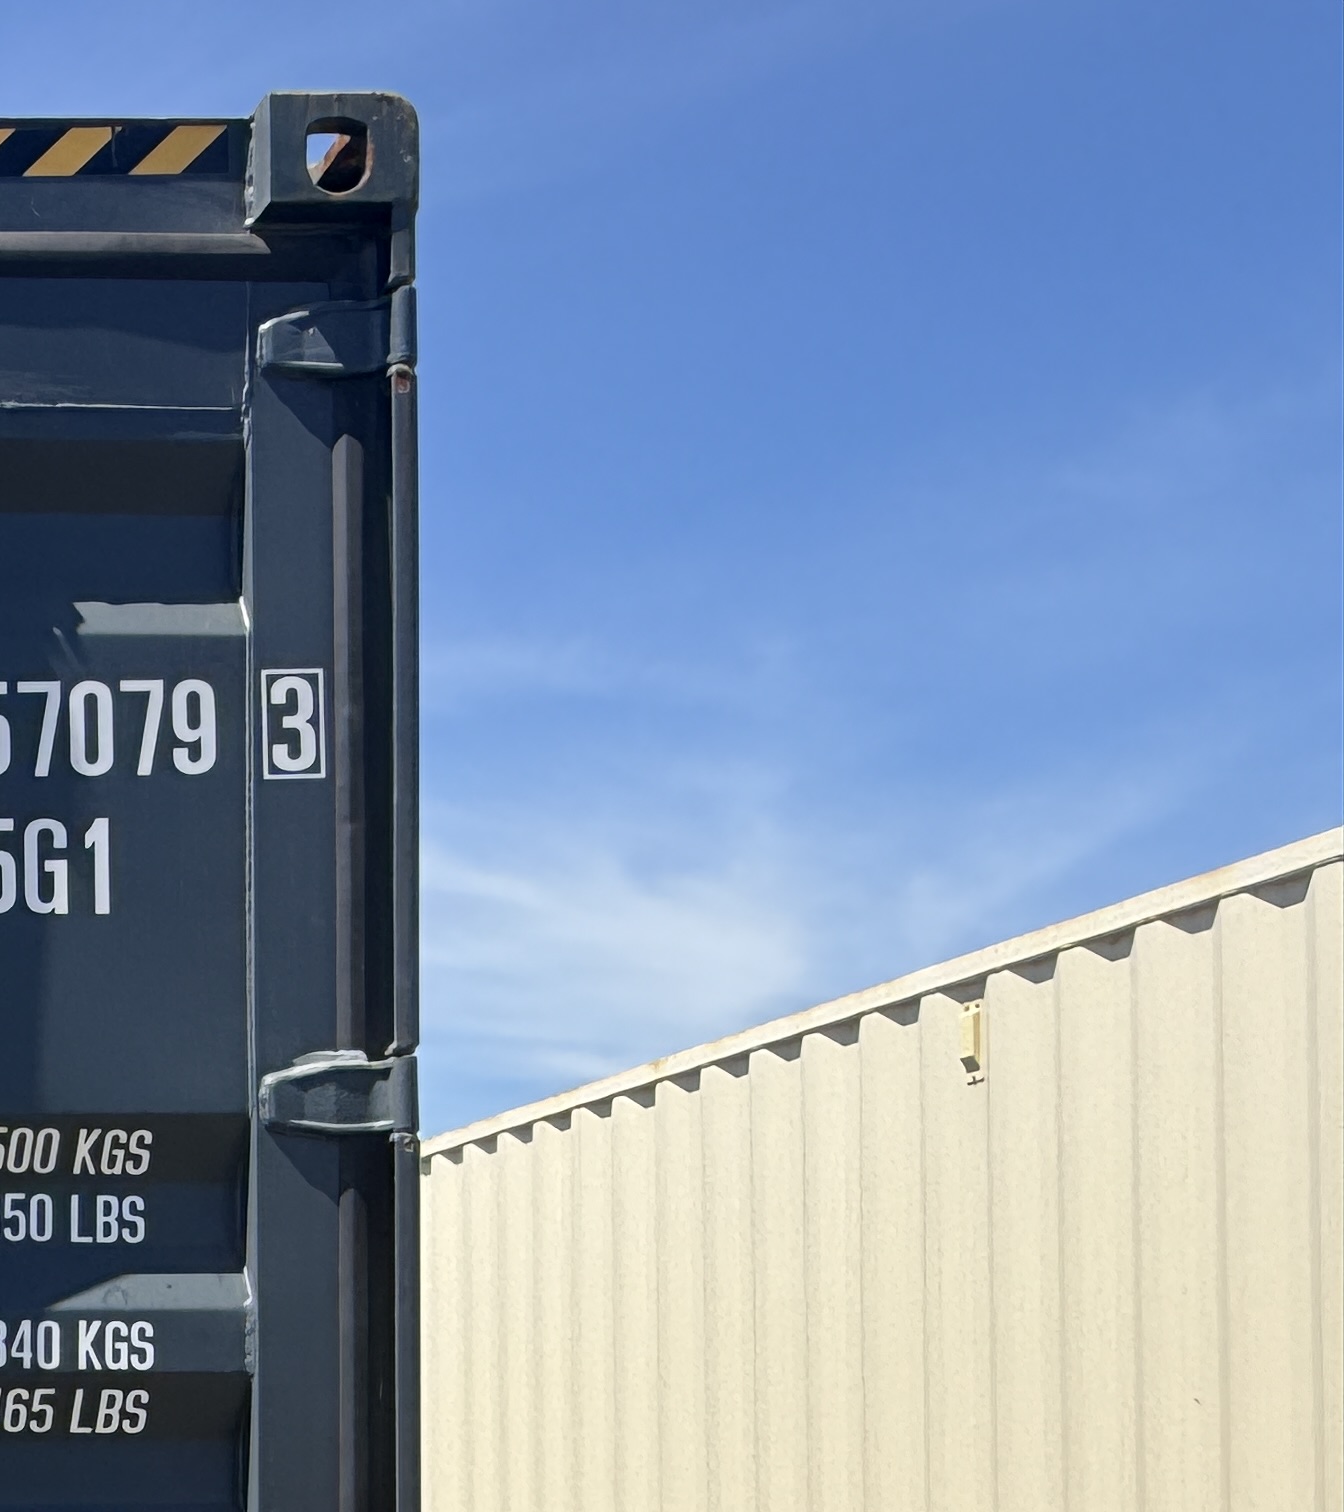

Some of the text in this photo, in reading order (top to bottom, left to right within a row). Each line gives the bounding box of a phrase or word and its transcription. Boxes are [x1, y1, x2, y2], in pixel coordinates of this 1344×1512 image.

[270, 675, 317, 772] 3
[72, 1128, 153, 1176] KGS
[70, 1194, 145, 1244] LBS
[77, 1319, 155, 1371] KGS
[69, 1388, 150, 1434] LBS
